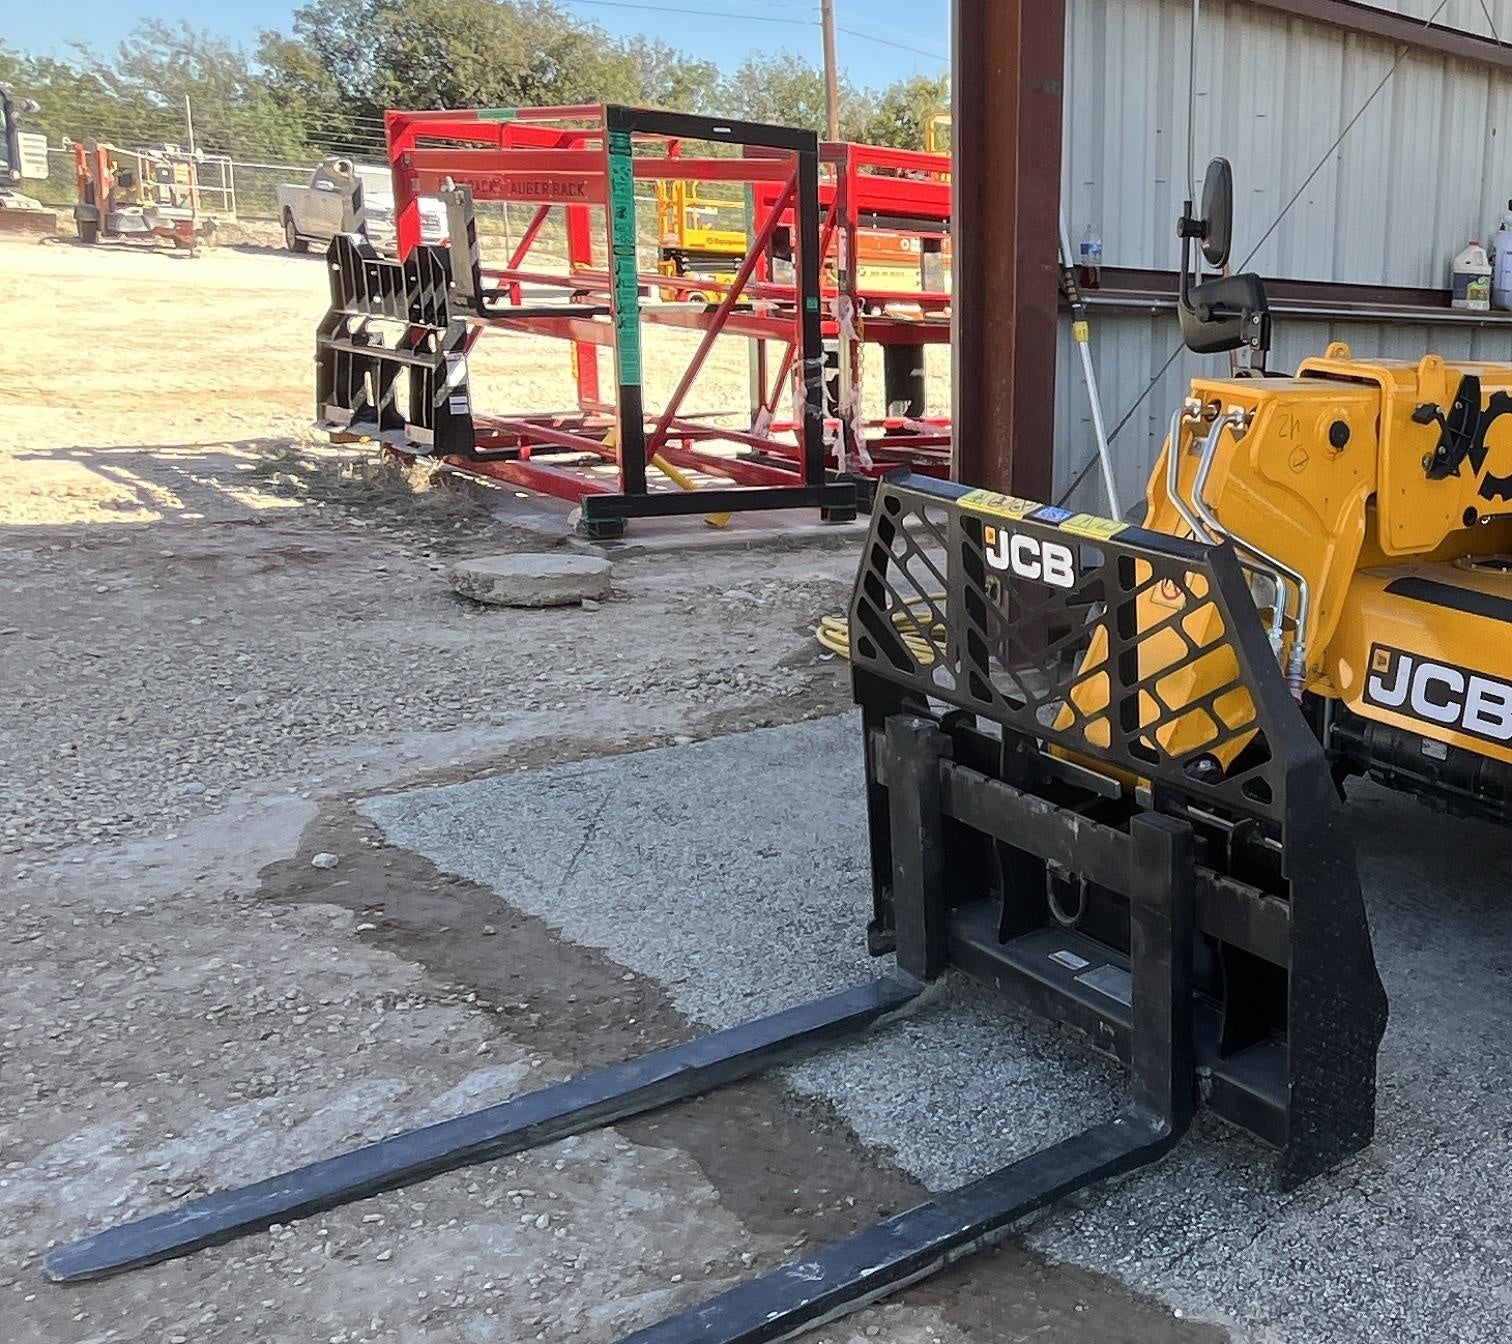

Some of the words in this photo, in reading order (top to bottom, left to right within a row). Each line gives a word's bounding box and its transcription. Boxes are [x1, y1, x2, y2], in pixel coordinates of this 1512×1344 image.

[510, 180, 549, 196] AUGER
[552, 182, 586, 197] RACK
[984, 529, 1075, 589] JCB
